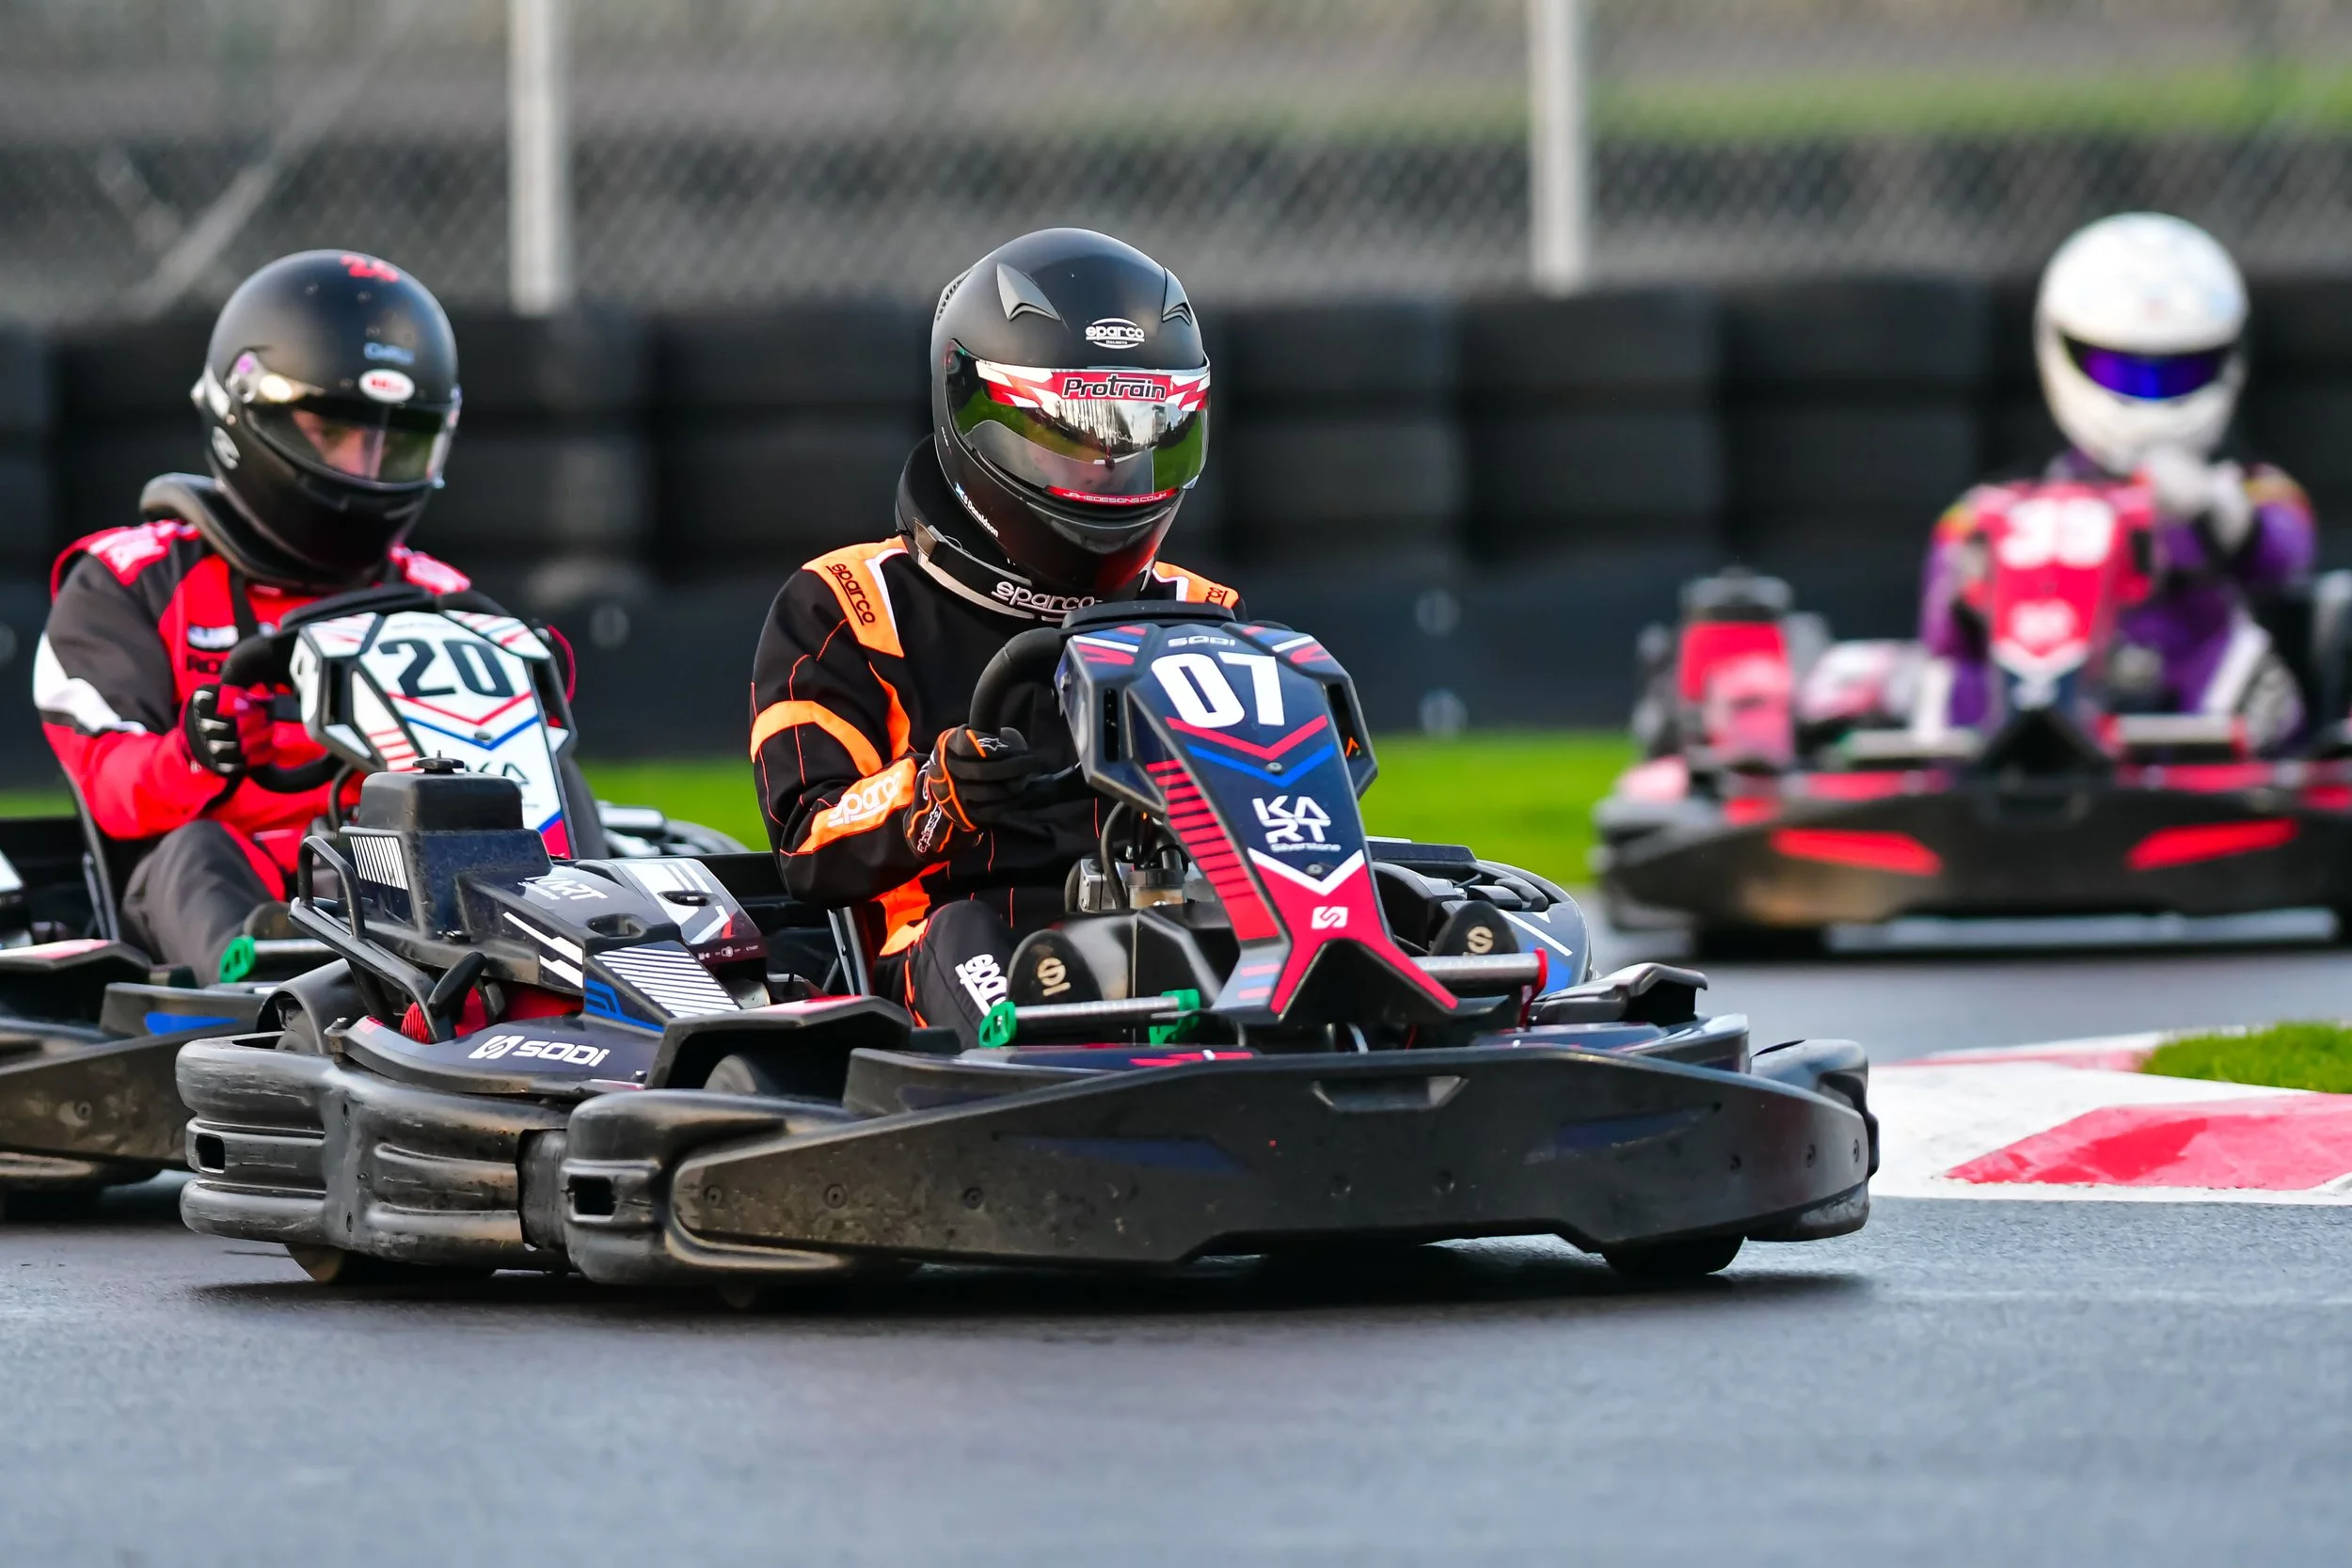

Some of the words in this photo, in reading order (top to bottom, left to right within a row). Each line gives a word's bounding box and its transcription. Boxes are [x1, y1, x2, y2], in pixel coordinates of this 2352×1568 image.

[1086, 325, 1144, 341] sparco
[1063, 373, 1167, 400] Protrain
[967, 499, 999, 538] Donaldson
[829, 563, 876, 624] sparco
[994, 581, 1095, 610] sparco
[1168, 635, 1236, 648] SODI
[378, 638, 515, 697] 20
[1151, 652, 1285, 729] 07
[958, 954, 1008, 1007] spa
